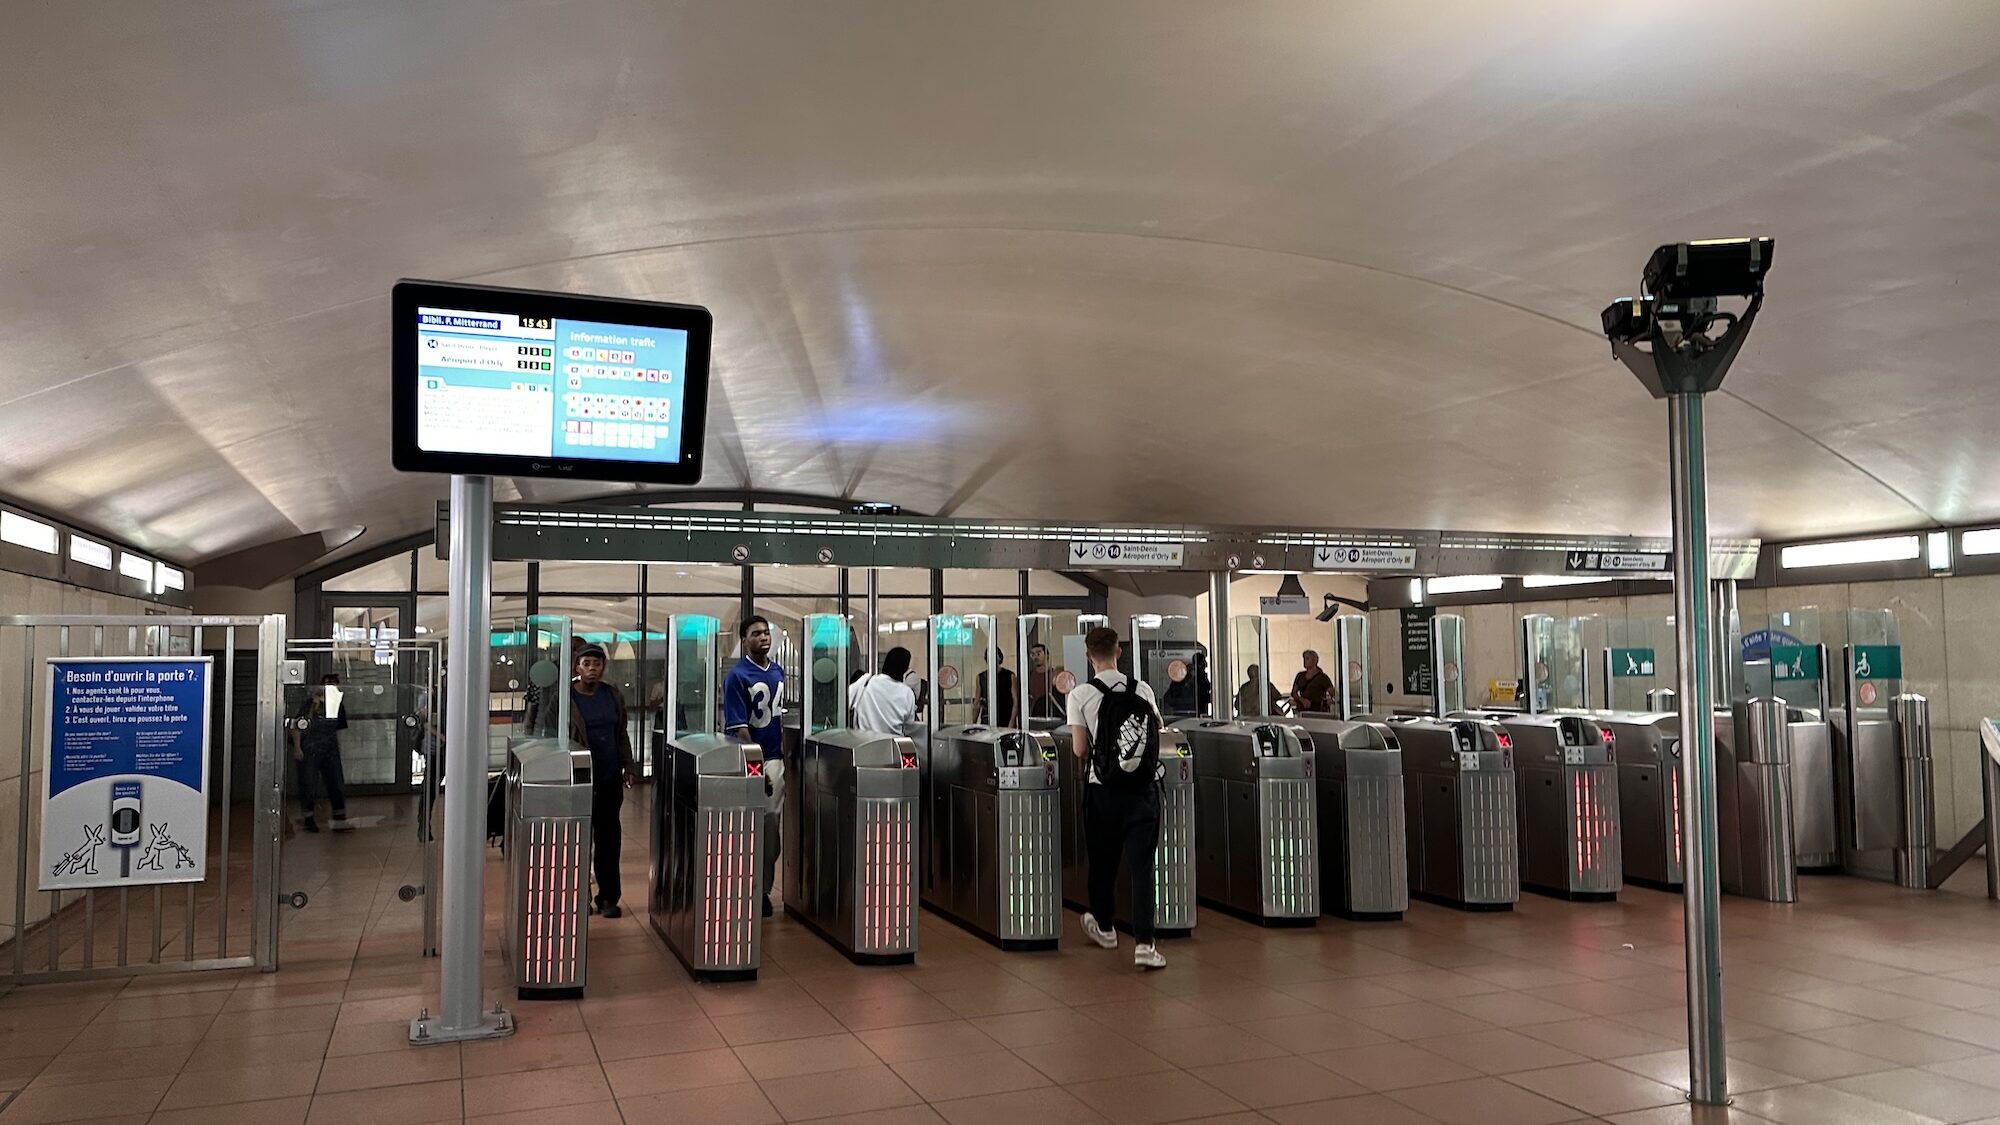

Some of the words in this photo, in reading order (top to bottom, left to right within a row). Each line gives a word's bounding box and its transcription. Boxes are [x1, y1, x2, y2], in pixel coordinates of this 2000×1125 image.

[422, 315, 444, 325] Bibli.
[453, 317, 498, 329] Mitterrand
[570, 331, 628, 345] Information
[630, 337, 657, 348] trafic
[1122, 552, 1150, 560] Aéroport
[1151, 553, 1169, 561] d'Orly
[1361, 556, 1386, 564] Aéroport
[66, 670, 101, 682] Besoin
[104, 670, 143, 682] d'ouvrir
[146, 669, 155, 681] la
[158, 670, 185, 684] porte
[187, 669, 194, 681] ?
[72, 687, 85, 695] Nos
[85, 687, 107, 696] agents
[131, 687, 145, 695] pour
[72, 695, 114, 703] contactez-les
[116, 695, 137, 704] depuis
[138, 695, 175, 703] l'interphone
[104, 706, 121, 715] jouer
[165, 704, 178, 712] titre
[747, 681, 784, 729] 34
[112, 715, 127, 723] tirez
[137, 715, 163, 724] poussez
[163, 714, 170, 722] la
[171, 714, 188, 723] porte
